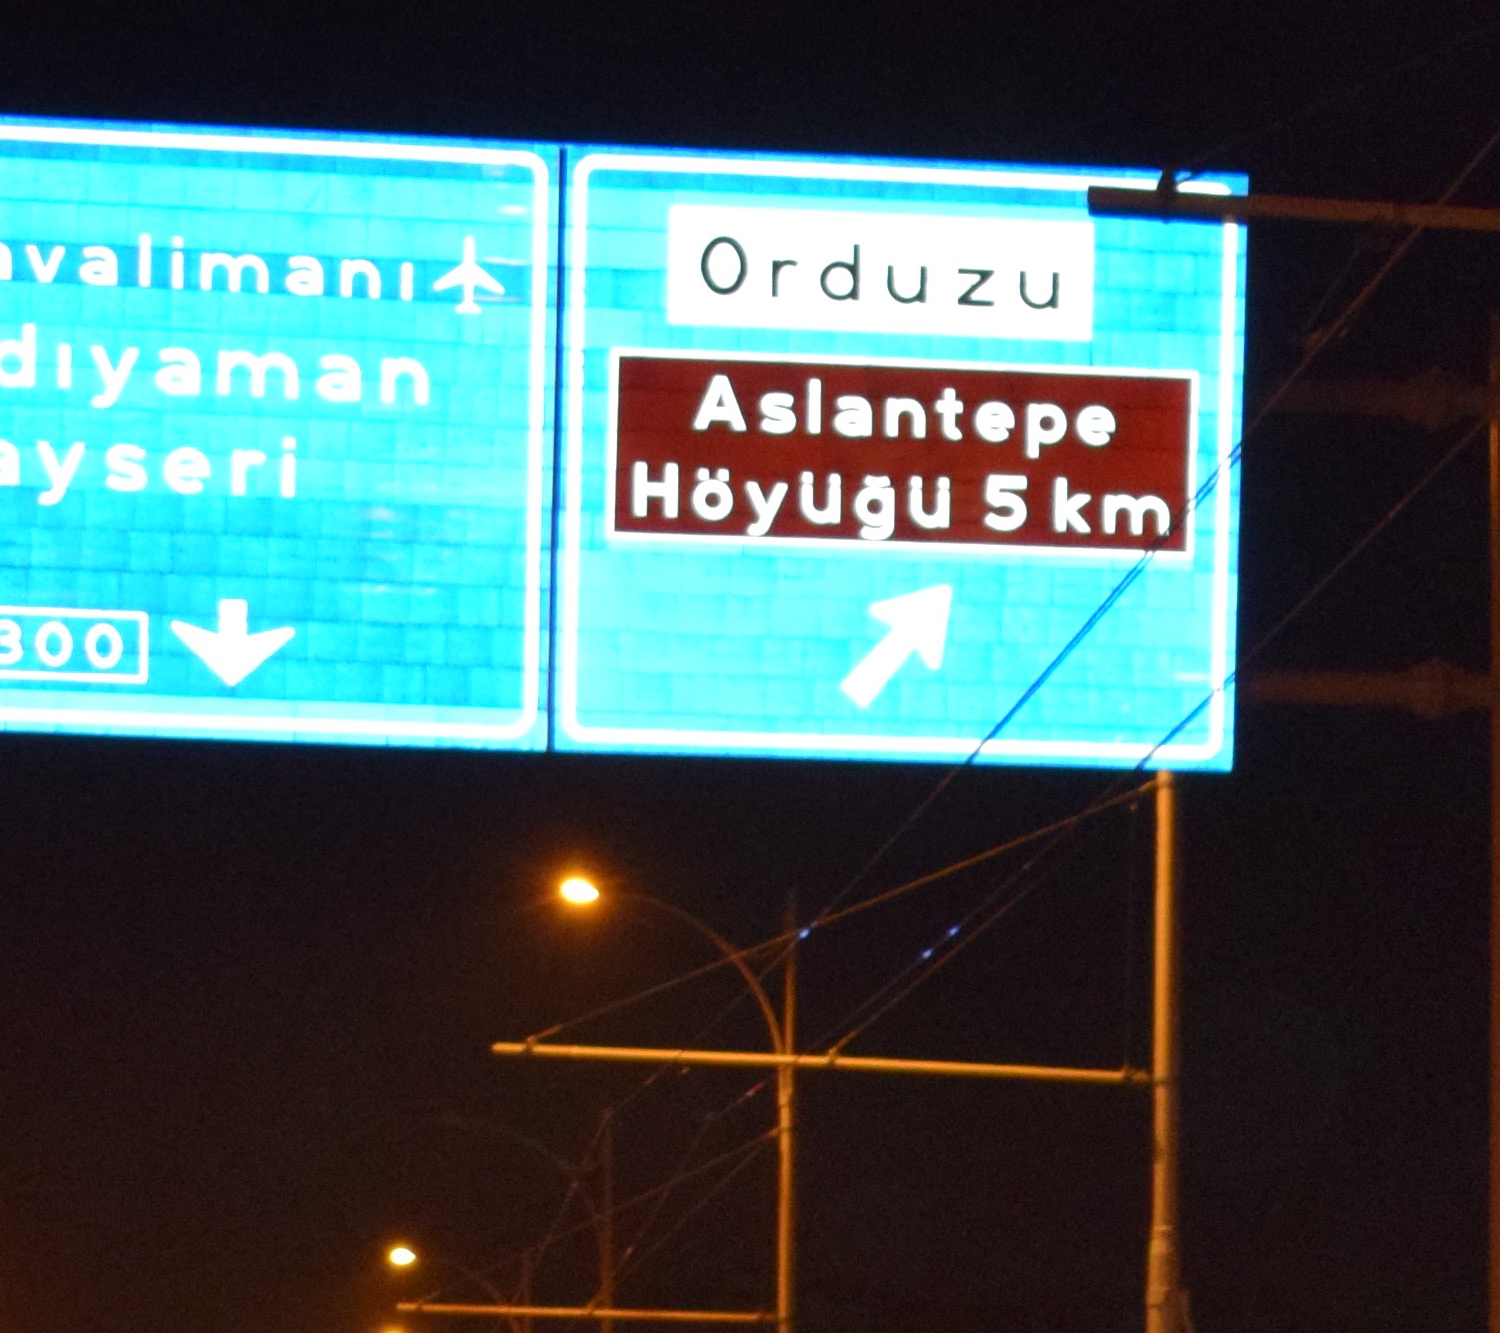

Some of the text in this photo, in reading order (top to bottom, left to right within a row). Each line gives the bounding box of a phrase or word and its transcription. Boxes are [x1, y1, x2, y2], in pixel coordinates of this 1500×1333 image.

[700, 235, 1060, 309] Orduzu
[692, 374, 1117, 459] Aslantepe
[631, 460, 1171, 541] Höyüğü 5 km
